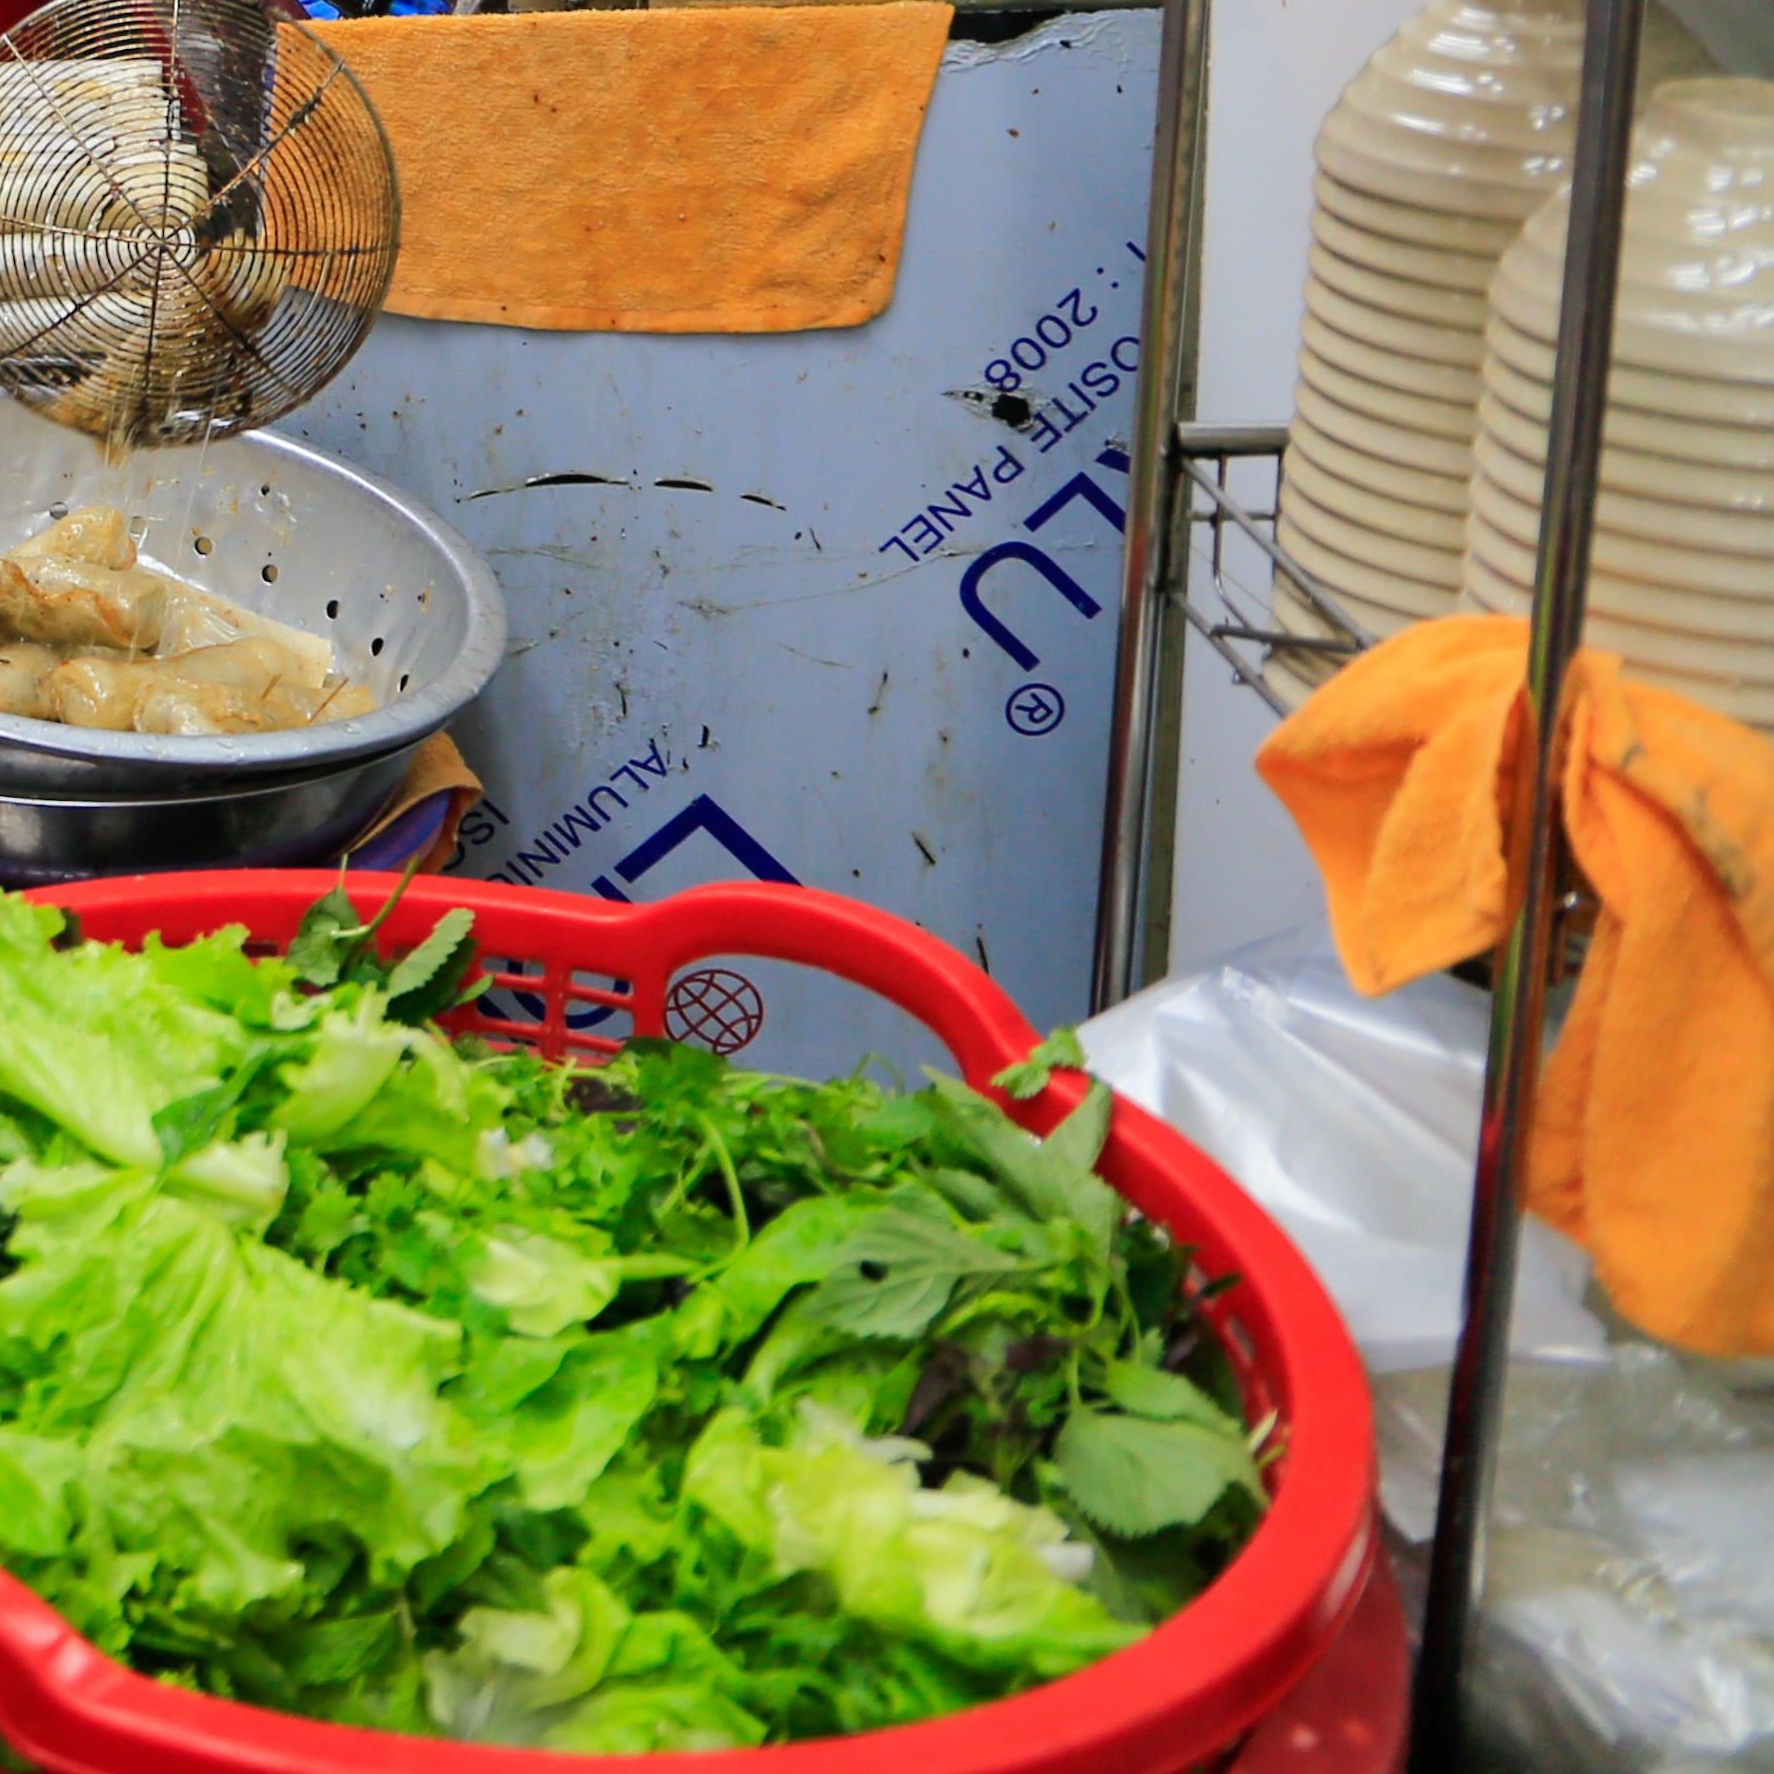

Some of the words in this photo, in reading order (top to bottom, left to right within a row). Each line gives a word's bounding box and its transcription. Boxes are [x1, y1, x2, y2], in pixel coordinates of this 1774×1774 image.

[983, 287, 1098, 393] 2008
[1029, 335, 1141, 454] OSITE
[878, 444, 1025, 562] PANEL
